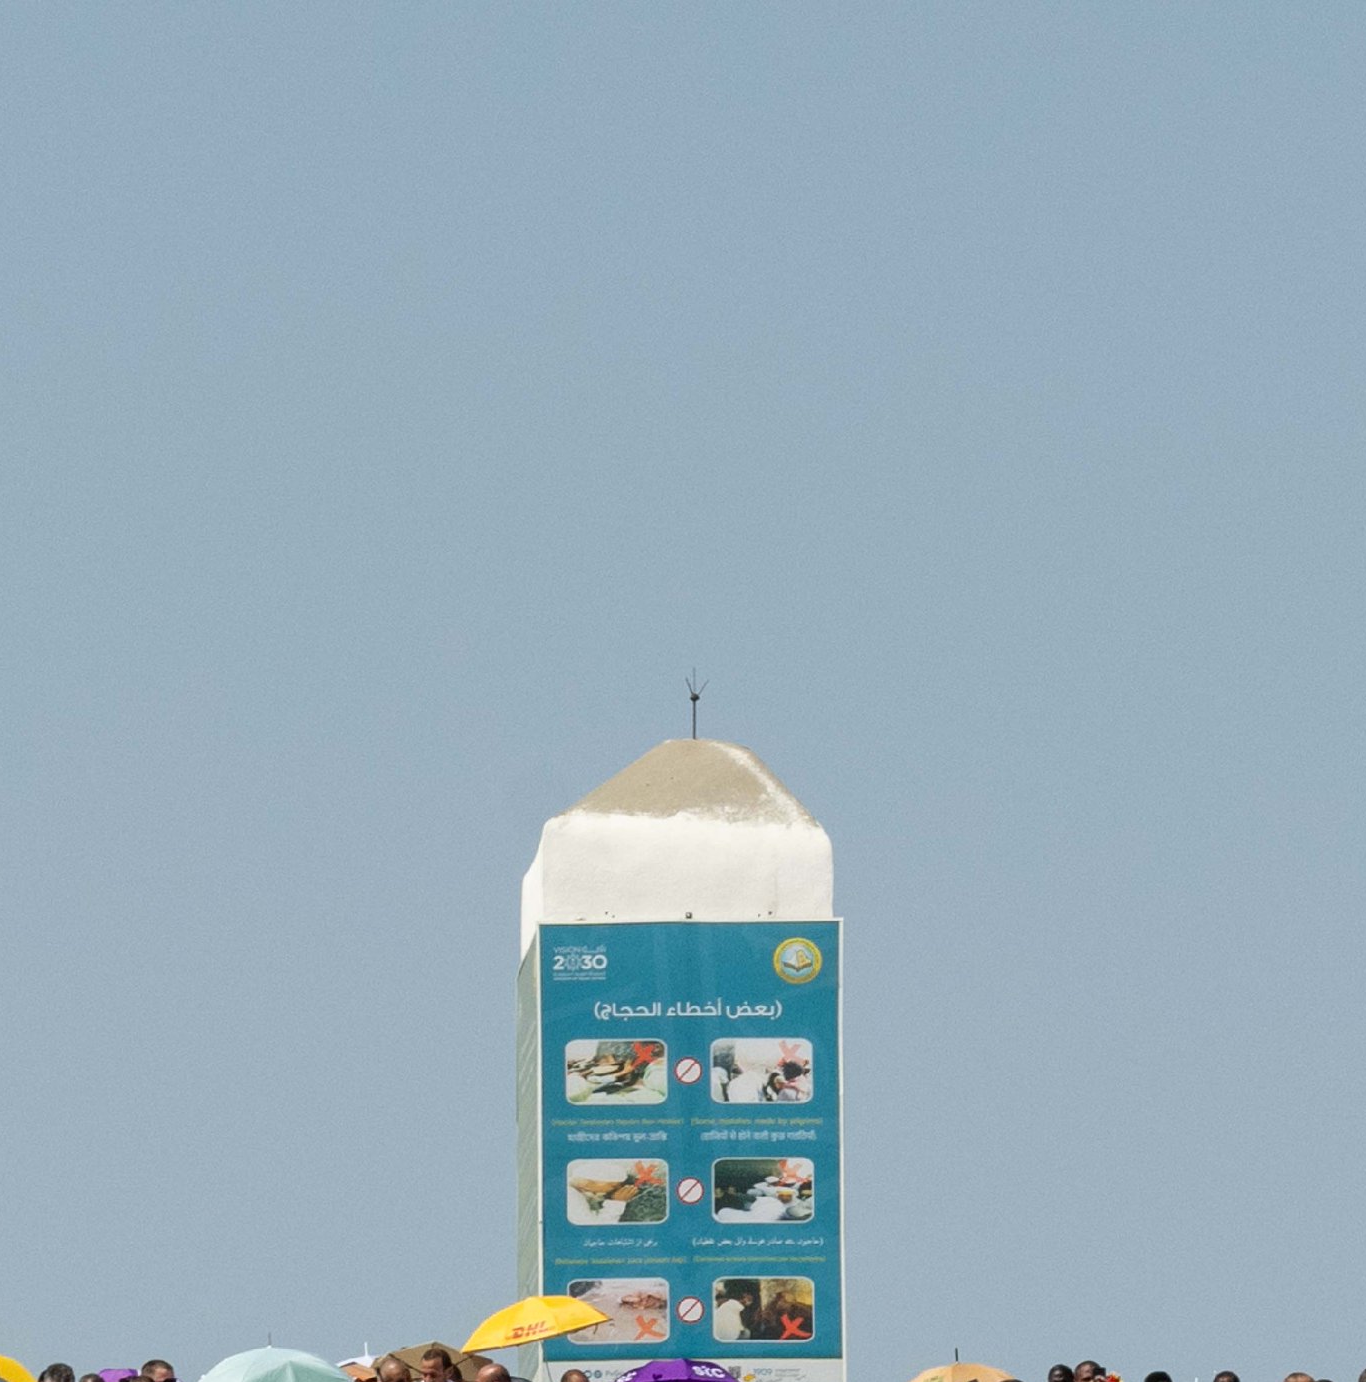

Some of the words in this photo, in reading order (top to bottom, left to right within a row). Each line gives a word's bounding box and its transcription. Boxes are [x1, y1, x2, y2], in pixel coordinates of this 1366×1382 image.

[593, 1000, 663, 1022] الحجاج)
[665, 996, 722, 1017] أخطاء
[726, 999, 783, 1021] (بعض
[510, 1320, 549, 1340] DHL
[691, 1365, 726, 1380] stc
